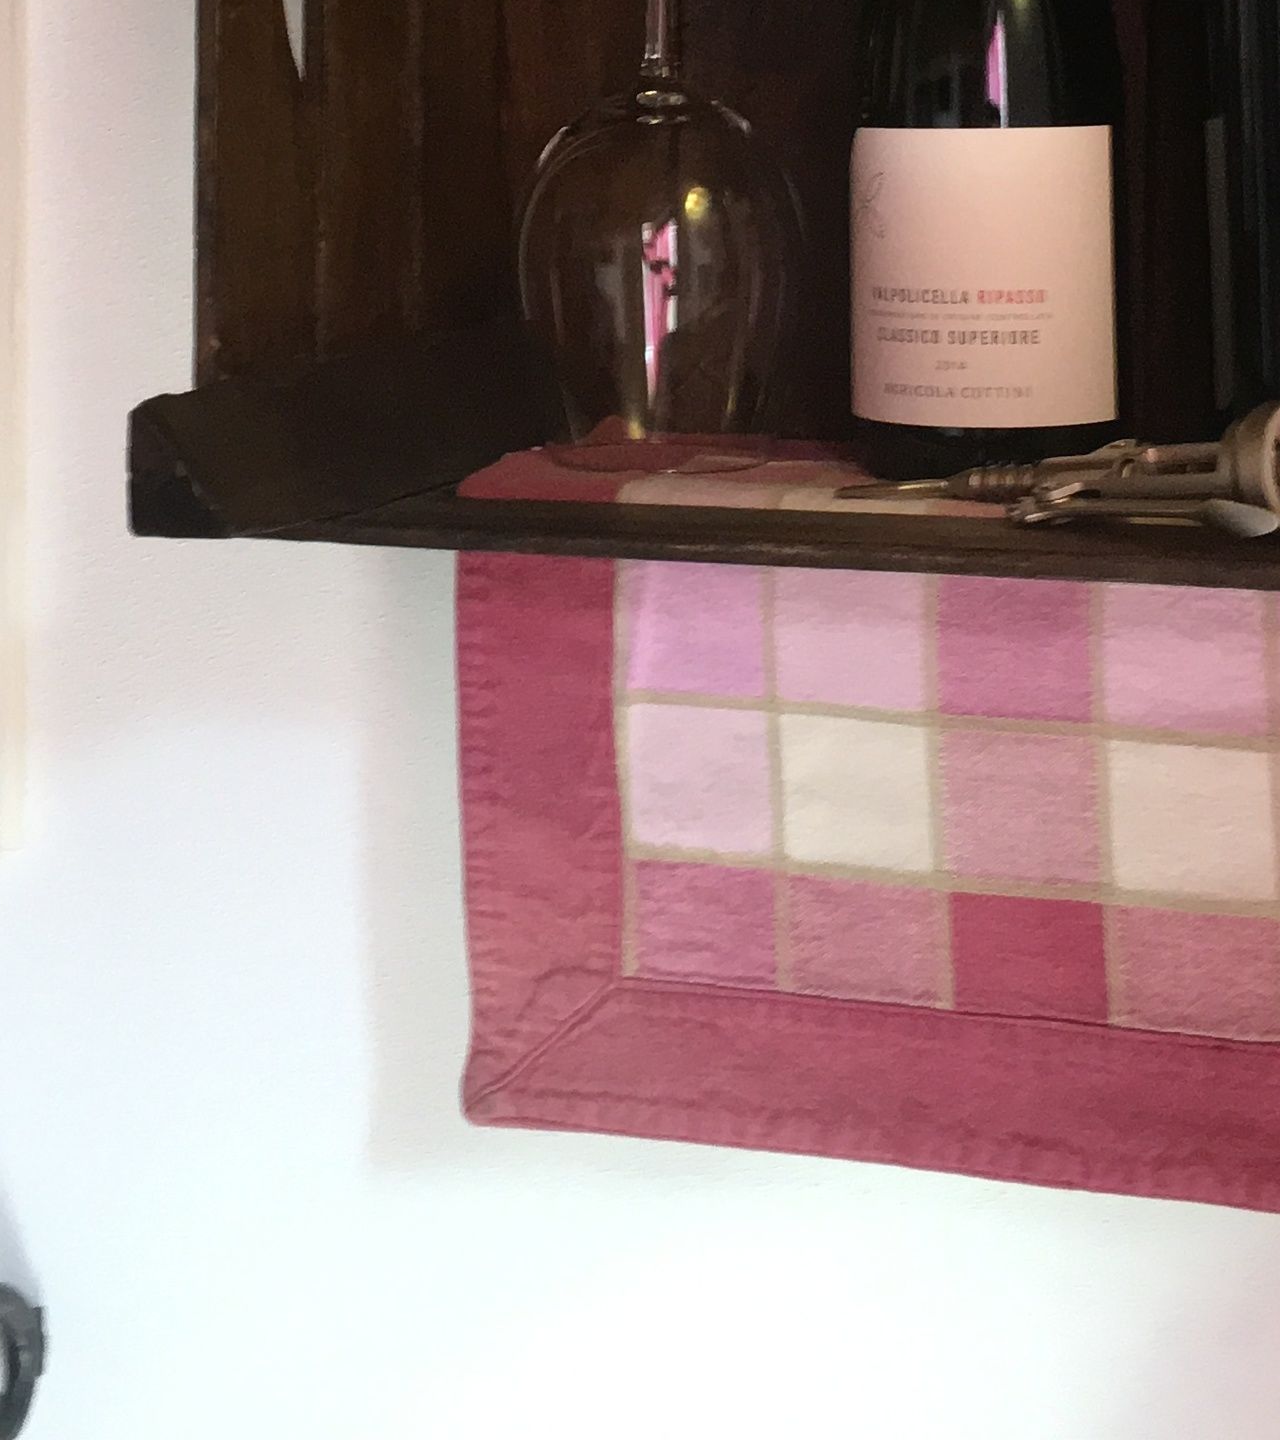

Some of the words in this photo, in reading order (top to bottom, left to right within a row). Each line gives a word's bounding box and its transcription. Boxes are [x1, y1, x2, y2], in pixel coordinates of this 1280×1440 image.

[871, 285, 970, 305] VALPOLICELLA
[976, 288, 1049, 305] RIPASSO
[876, 326, 940, 345] CLASSICO
[946, 328, 1042, 346] SUPERIORE
